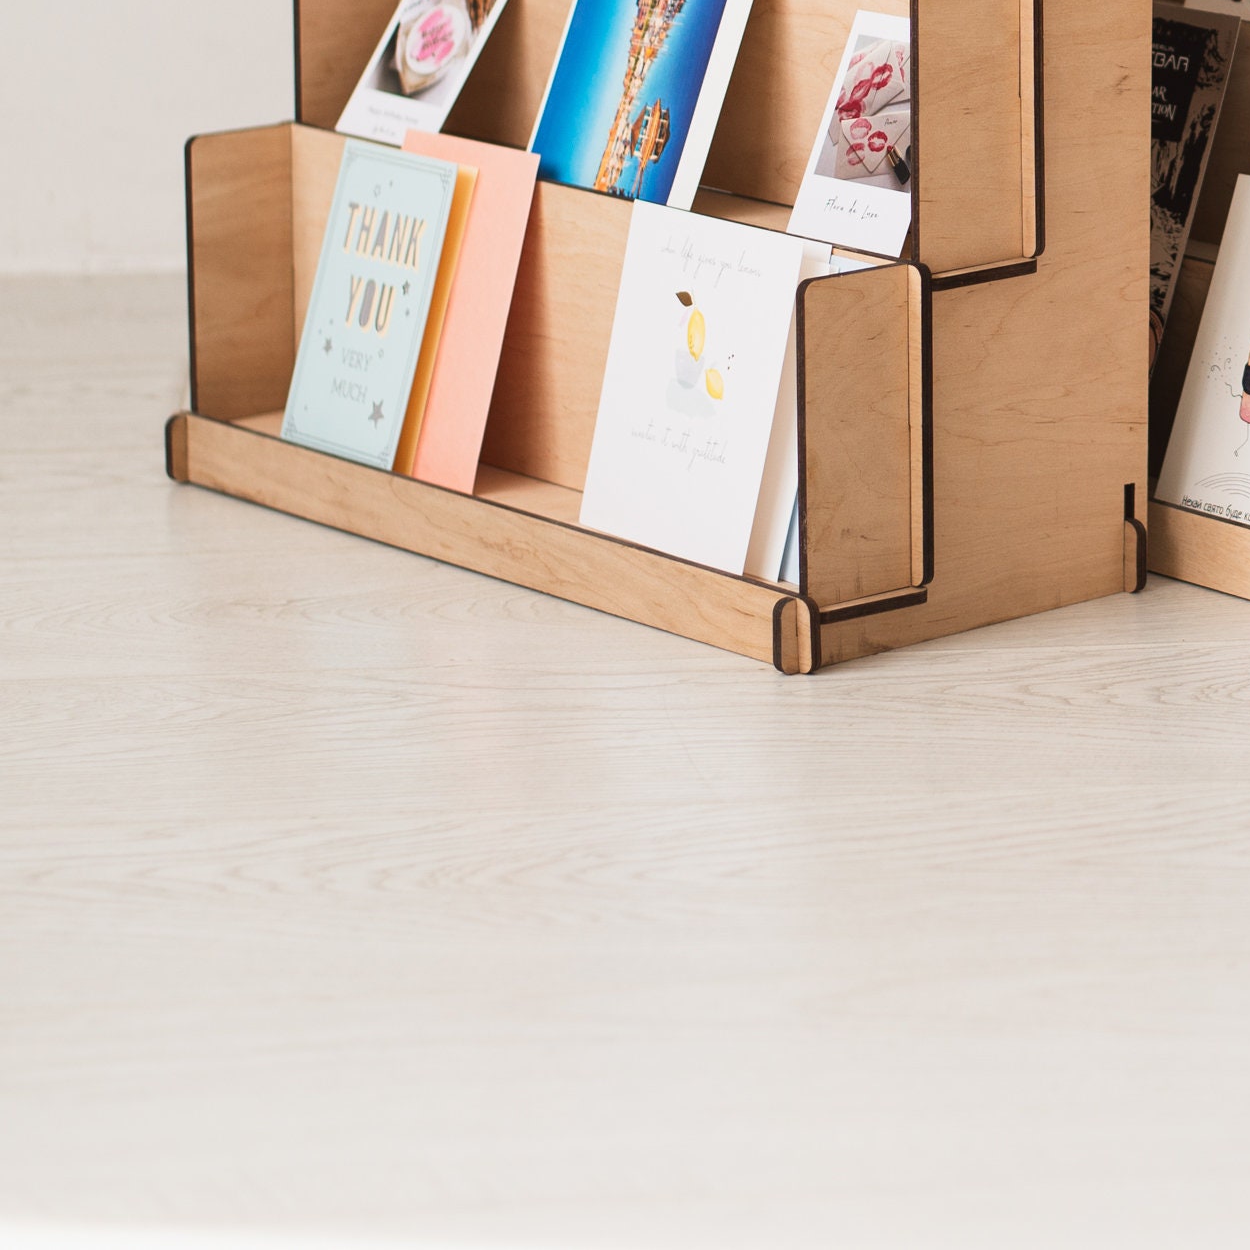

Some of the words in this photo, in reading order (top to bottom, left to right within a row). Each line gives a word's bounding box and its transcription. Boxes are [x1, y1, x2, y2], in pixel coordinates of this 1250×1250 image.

[1152, 102, 1177, 121] TION
[343, 201, 427, 272] THANK
[344, 273, 396, 338] YOU
[341, 347, 372, 372] VERY
[1203, 502, 1224, 515] свято
[1225, 504, 1242, 519] буде
